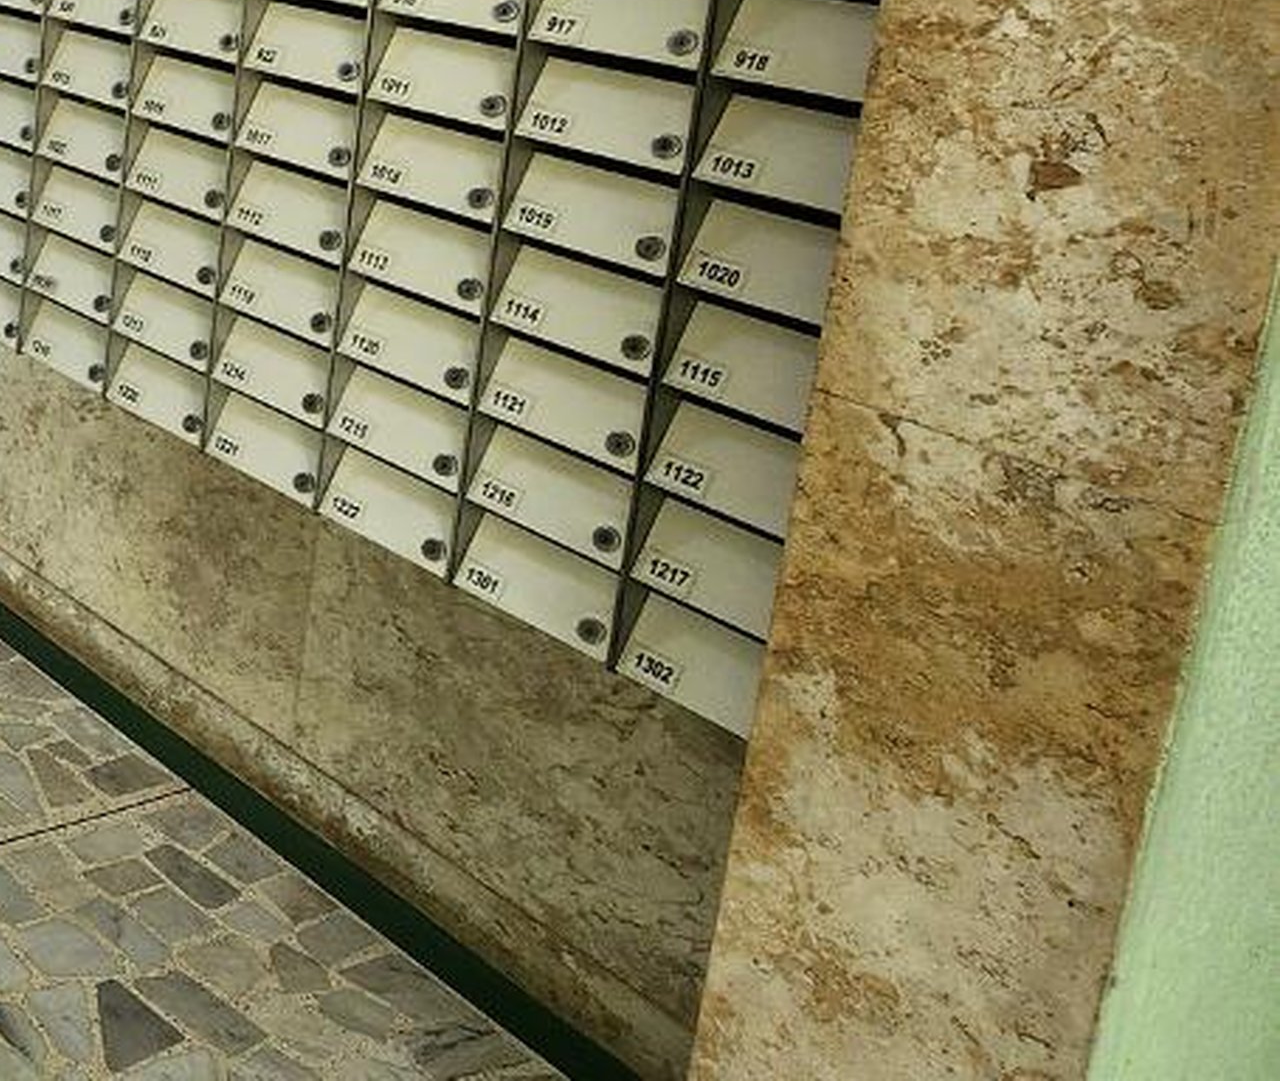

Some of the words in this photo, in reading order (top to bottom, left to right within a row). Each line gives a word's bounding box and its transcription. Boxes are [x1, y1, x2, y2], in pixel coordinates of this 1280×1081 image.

[546, 17, 576, 34] 917
[734, 50, 769, 71] 918
[382, 78, 410, 95] 1011
[532, 113, 567, 133] 1012
[713, 156, 755, 178] 1013
[699, 262, 740, 287] 1020
[506, 299, 540, 322] 1114
[681, 361, 722, 387] 1115
[494, 391, 525, 414] 1121
[665, 461, 704, 490] 1122
[466, 567, 498, 593] 1301
[649, 559, 690, 586] 1217
[635, 654, 674, 683] 1302
